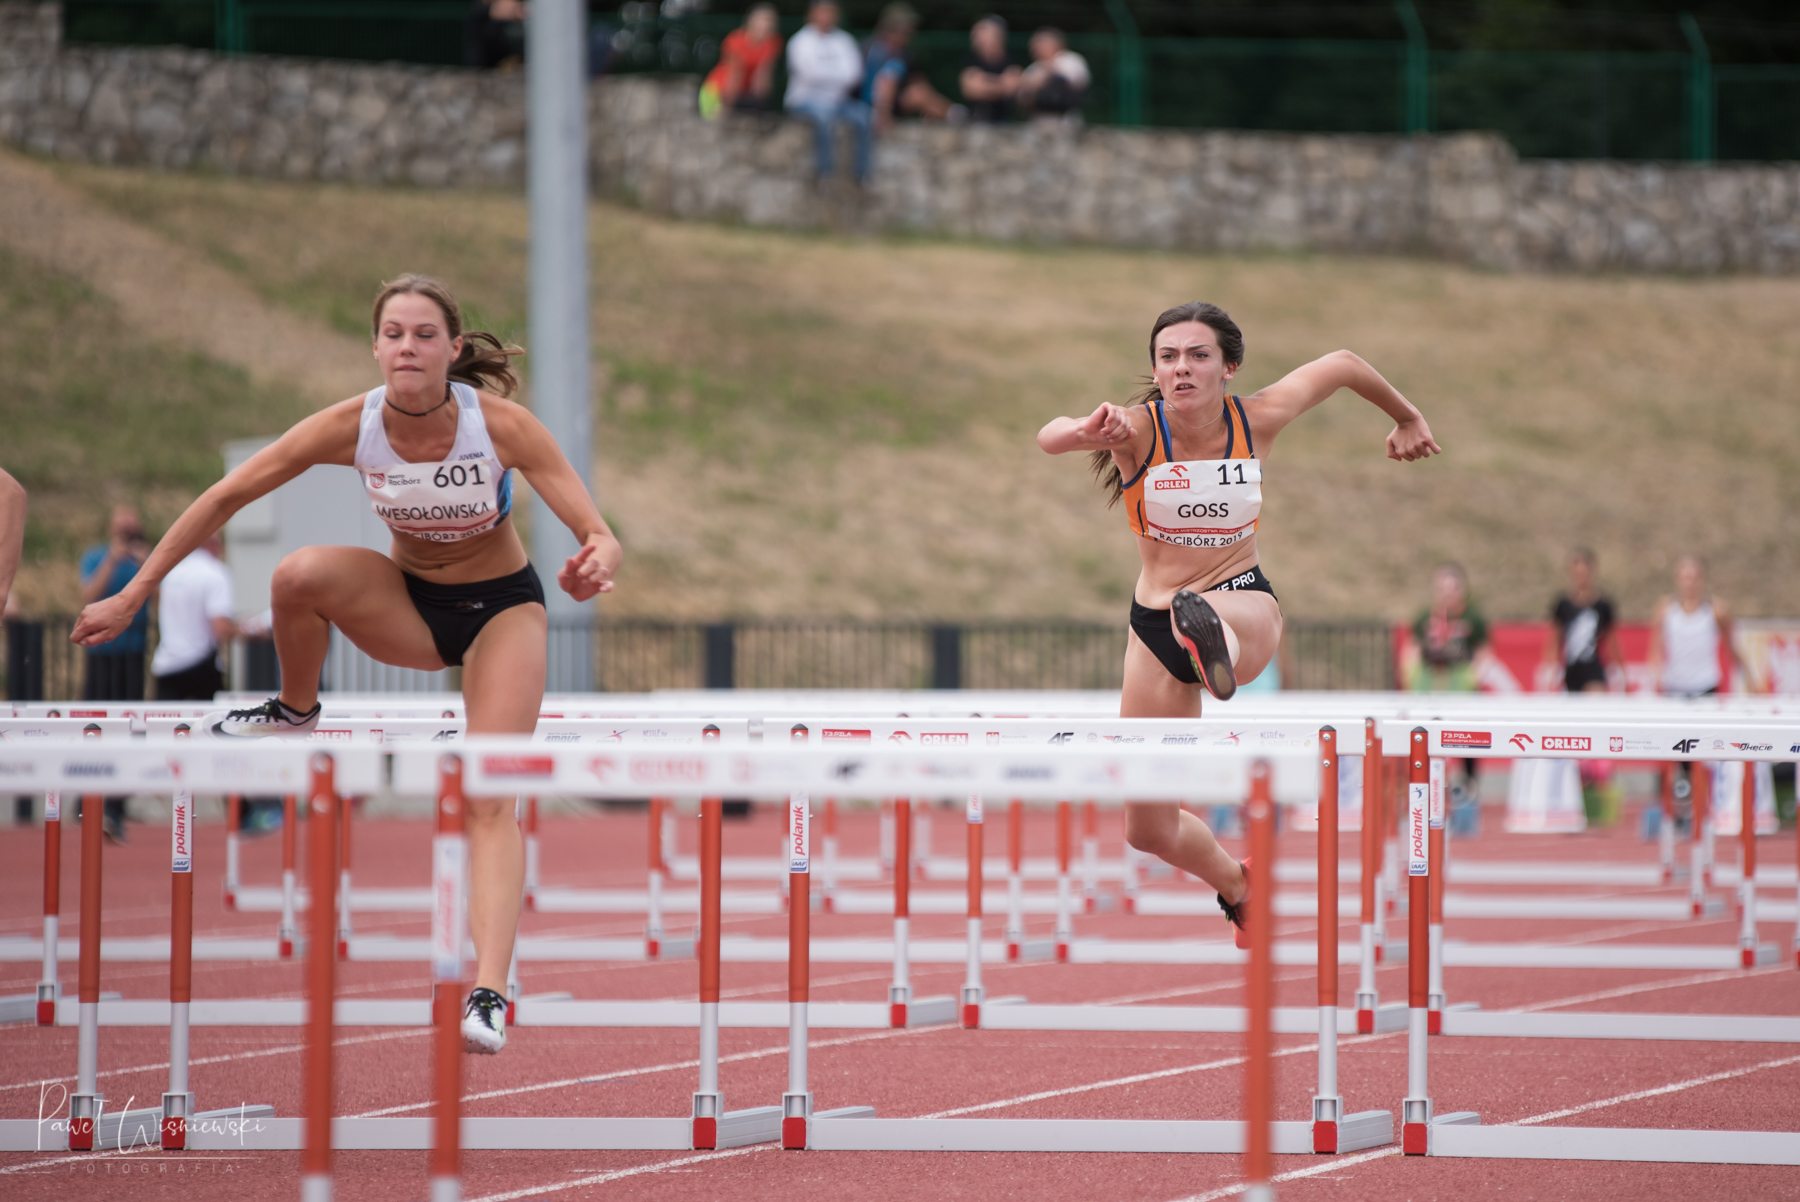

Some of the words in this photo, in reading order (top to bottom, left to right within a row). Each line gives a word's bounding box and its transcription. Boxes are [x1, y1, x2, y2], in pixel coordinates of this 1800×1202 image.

[457, 451, 485, 461] JUVENIA
[387, 478, 421, 486] Racibórz
[433, 464, 485, 488] 601
[1217, 463, 1248, 486] 11
[1156, 480, 1188, 490] ORLEN
[375, 501, 490, 521] WESOŁOWSKA
[1177, 502, 1229, 519] GOSS
[406, 531, 456, 541] CIBÓRZ
[460, 525, 487, 538] 2019
[1159, 532, 1216, 547] RACIBÓRZ
[1219, 531, 1243, 547] 2019
[1231, 571, 1256, 591] PRO
[922, 734, 967, 746] ORLEN
[1046, 732, 1075, 746] 4F
[1160, 737, 1199, 746] 4MOVE
[1543, 738, 1589, 750] ORLEN
[1672, 739, 1700, 753] 4F
[174, 804, 188, 855] polanik
[792, 804, 806, 856] polanik
[1411, 807, 1425, 858] polanik
